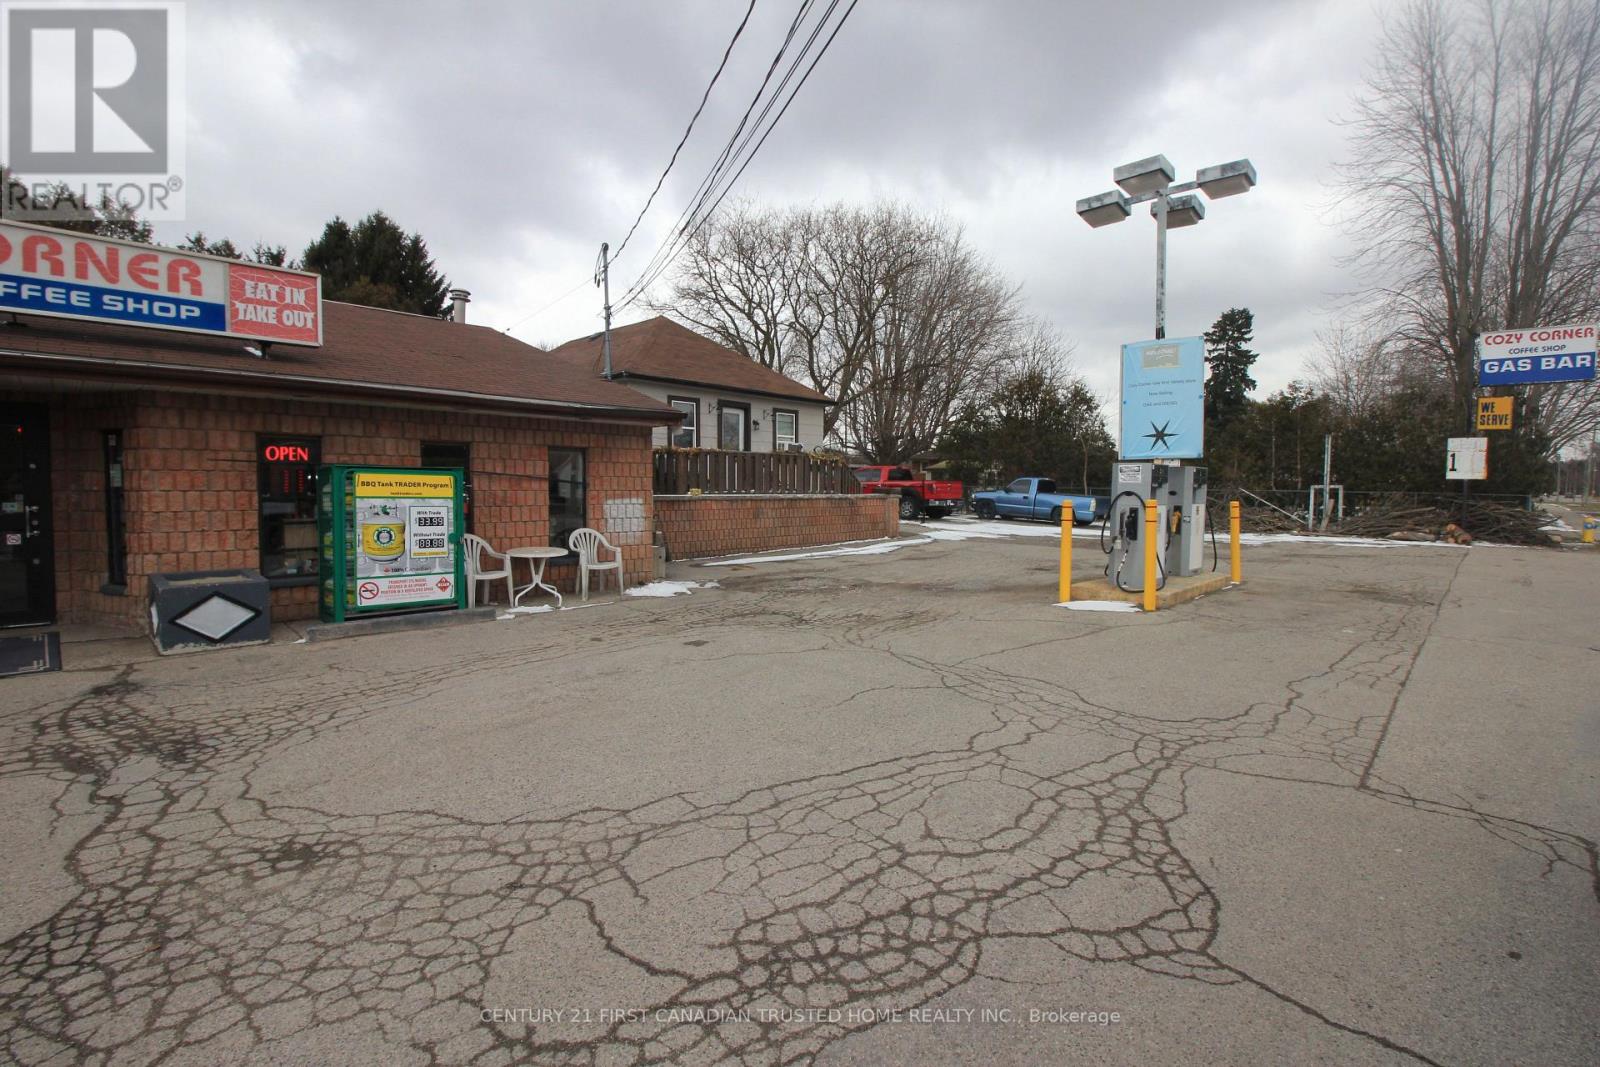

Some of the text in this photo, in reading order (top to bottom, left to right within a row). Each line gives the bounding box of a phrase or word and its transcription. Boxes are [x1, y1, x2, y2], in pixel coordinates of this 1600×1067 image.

[245, 281, 305, 306] EAT IN
[102, 294, 200, 320] SHOP
[236, 303, 314, 329] TAKE OUT
[1485, 327, 1594, 346] COZY CORNER
[1508, 344, 1567, 355] COFFEE SHOP
[1484, 354, 1592, 374] GAS BAR
[1481, 402, 1496, 413] WE
[1480, 414, 1508, 426] SERVE
[265, 445, 308, 461] OPEN
[1449, 452, 1457, 472] 1
[361, 480, 376, 488] BBQ
[422, 481, 449, 490] Program
